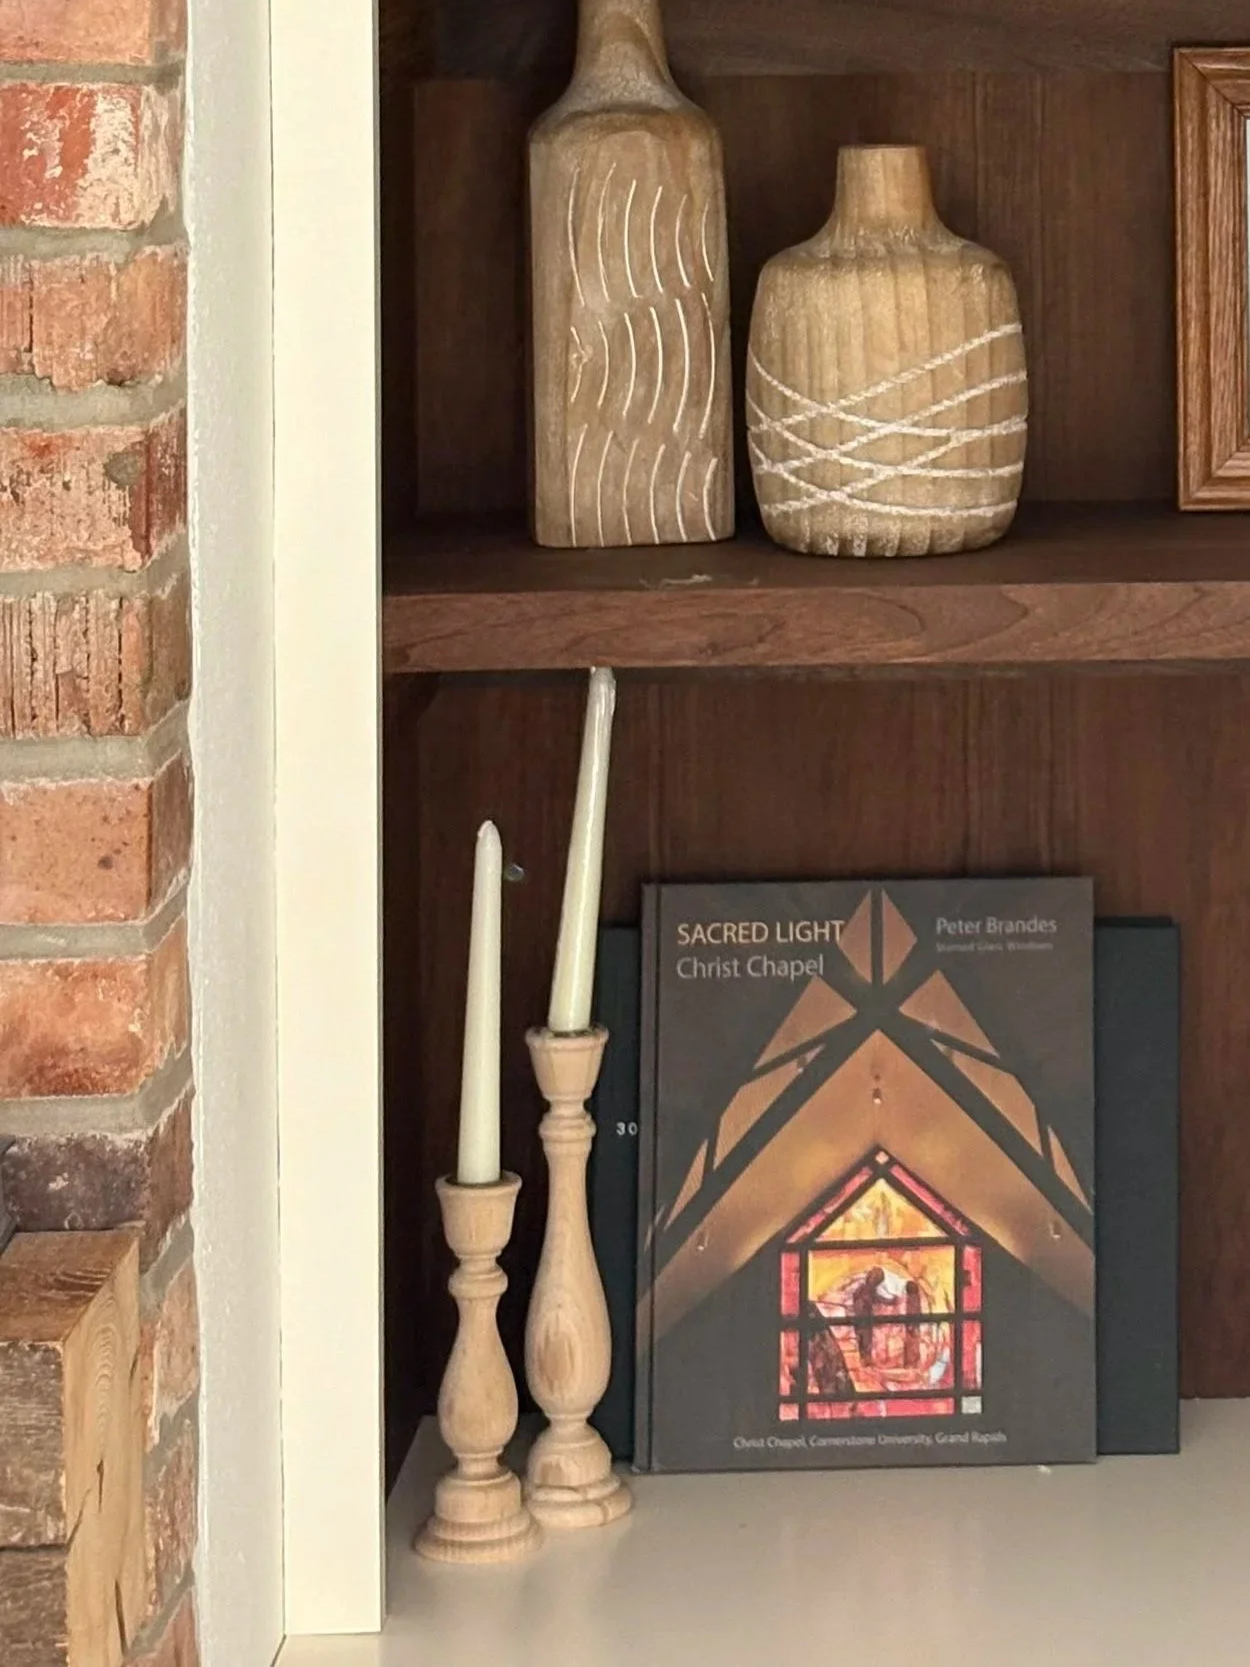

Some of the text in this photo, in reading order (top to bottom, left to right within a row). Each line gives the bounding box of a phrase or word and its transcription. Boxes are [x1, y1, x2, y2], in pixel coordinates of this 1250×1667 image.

[676, 920, 846, 945] SACRED LIGHT
[936, 915, 1058, 934] Peter Brandes
[676, 953, 824, 982] Christ Chapel
[935, 1431, 969, 1443] Grand
